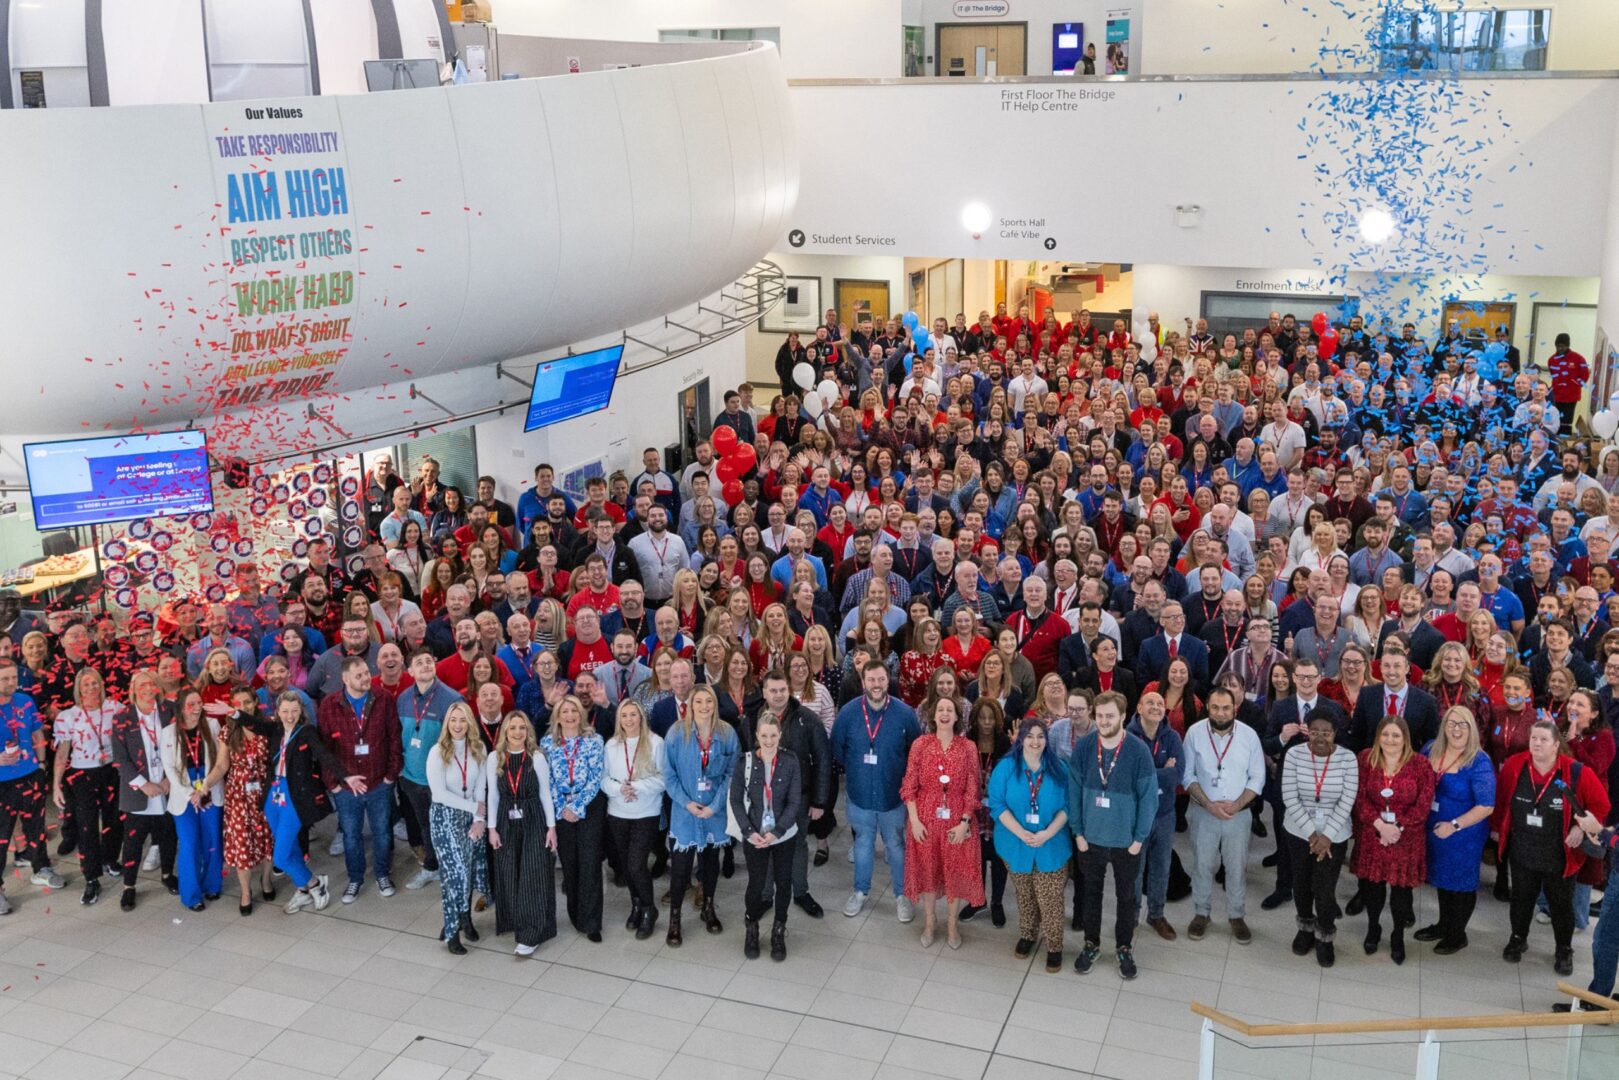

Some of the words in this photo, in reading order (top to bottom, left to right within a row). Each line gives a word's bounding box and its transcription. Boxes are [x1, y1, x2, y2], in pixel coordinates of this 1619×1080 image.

[984, 4, 1006, 13] Bridge
[1001, 89, 1024, 100] First
[1026, 89, 1054, 100] Floor
[1055, 89, 1077, 100] The
[1079, 88, 1116, 102] Bridge
[245, 107, 264, 120] Our
[265, 107, 303, 119] Values
[1001, 101, 1011, 111] IT
[1013, 101, 1039, 113] Help
[1041, 101, 1078, 111] Centre
[215, 135, 247, 158] TAKE
[247, 131, 339, 156] RESPONSIBILITY
[227, 171, 282, 224] AIM
[284, 167, 349, 219] HIGH
[1000, 217, 1027, 228] Sports
[1029, 218, 1045, 227] Hall
[812, 233, 852, 245] Student
[855, 234, 896, 246] Services
[1000, 229, 1019, 239] Café
[1021, 230, 1040, 239] Vibe
[230, 234, 296, 266] RESPECT
[299, 228, 353, 259] OTHERS
[1236, 280, 1291, 291] Enrolment
[1295, 280, 1322, 292] Desk
[235, 276, 298, 317] WORK
[303, 270, 354, 310] HARD
[231, 331, 254, 354] DO
[256, 322, 309, 351] WHAT'S
[310, 317, 351, 344] RIGHT
[116, 464, 130, 473] Are
[126, 470, 156, 479] Colege
